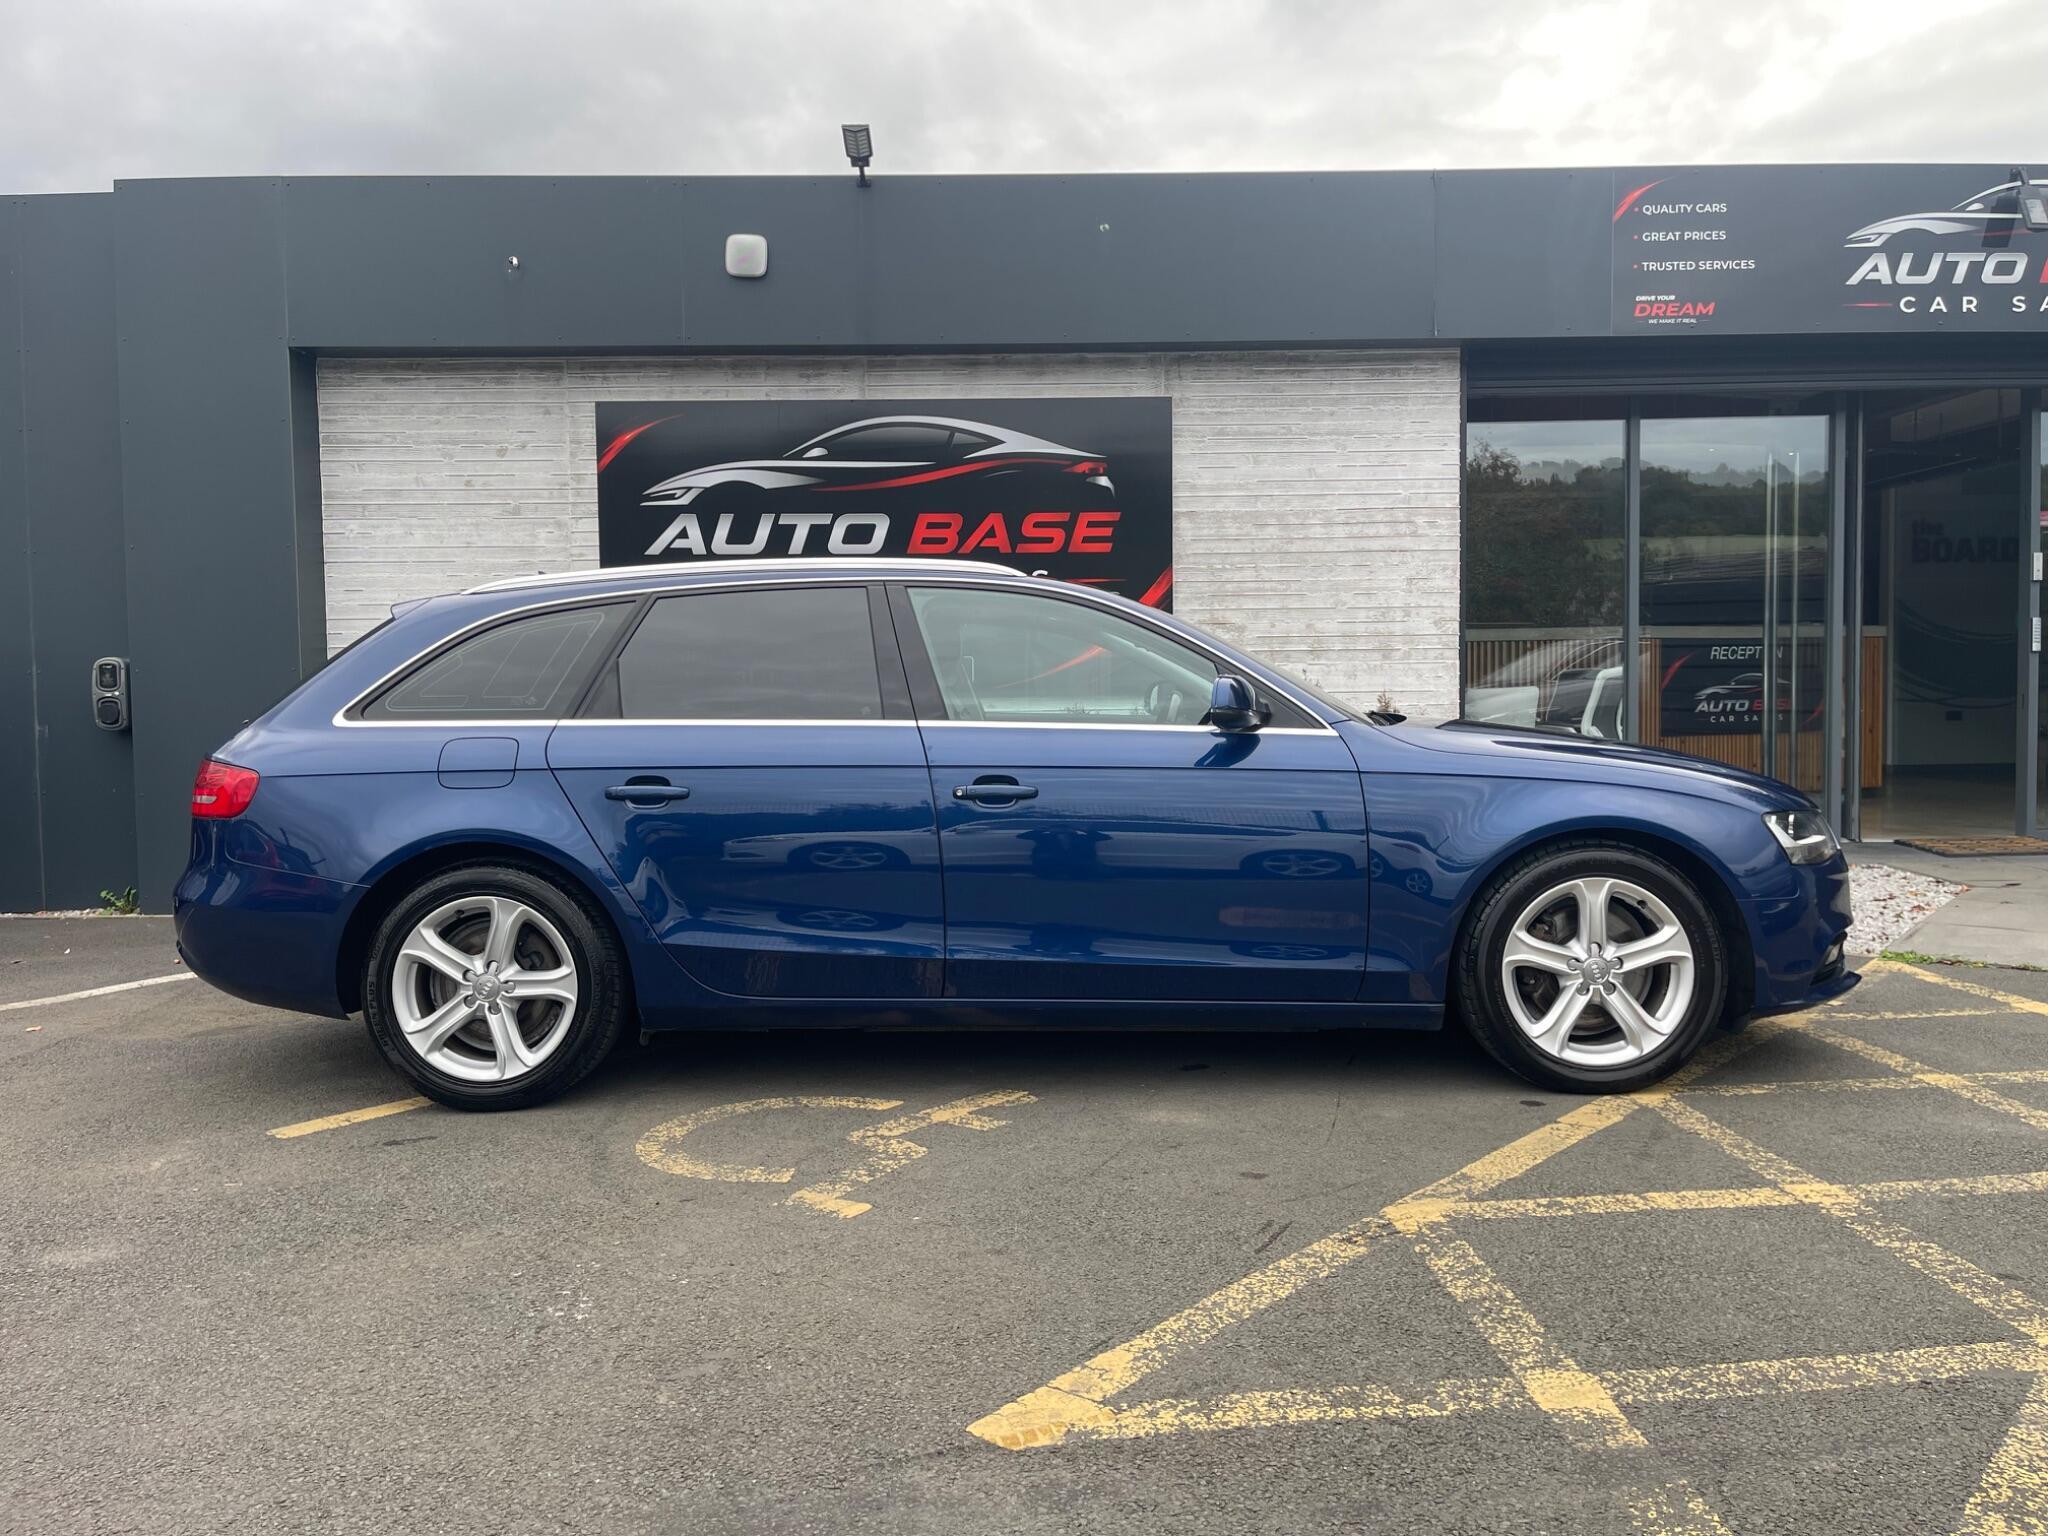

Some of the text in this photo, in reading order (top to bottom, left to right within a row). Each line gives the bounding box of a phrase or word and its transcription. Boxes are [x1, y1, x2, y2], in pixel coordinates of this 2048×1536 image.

[1642, 203, 1728, 215] QUALITY CARS
[1642, 230, 1727, 242] GREAT PRICES
[1642, 260, 1756, 271] TRUSTED SERVICES
[1845, 252, 2029, 285] AUTO
[1634, 302, 1716, 317] DREAM
[1899, 296, 1979, 313] CAR
[643, 511, 1122, 557] AUTO BASE
[1710, 646, 1784, 660] RECEPTN
[1694, 699, 1750, 713] AUTO
[1710, 713, 1784, 723] CAR SAS
